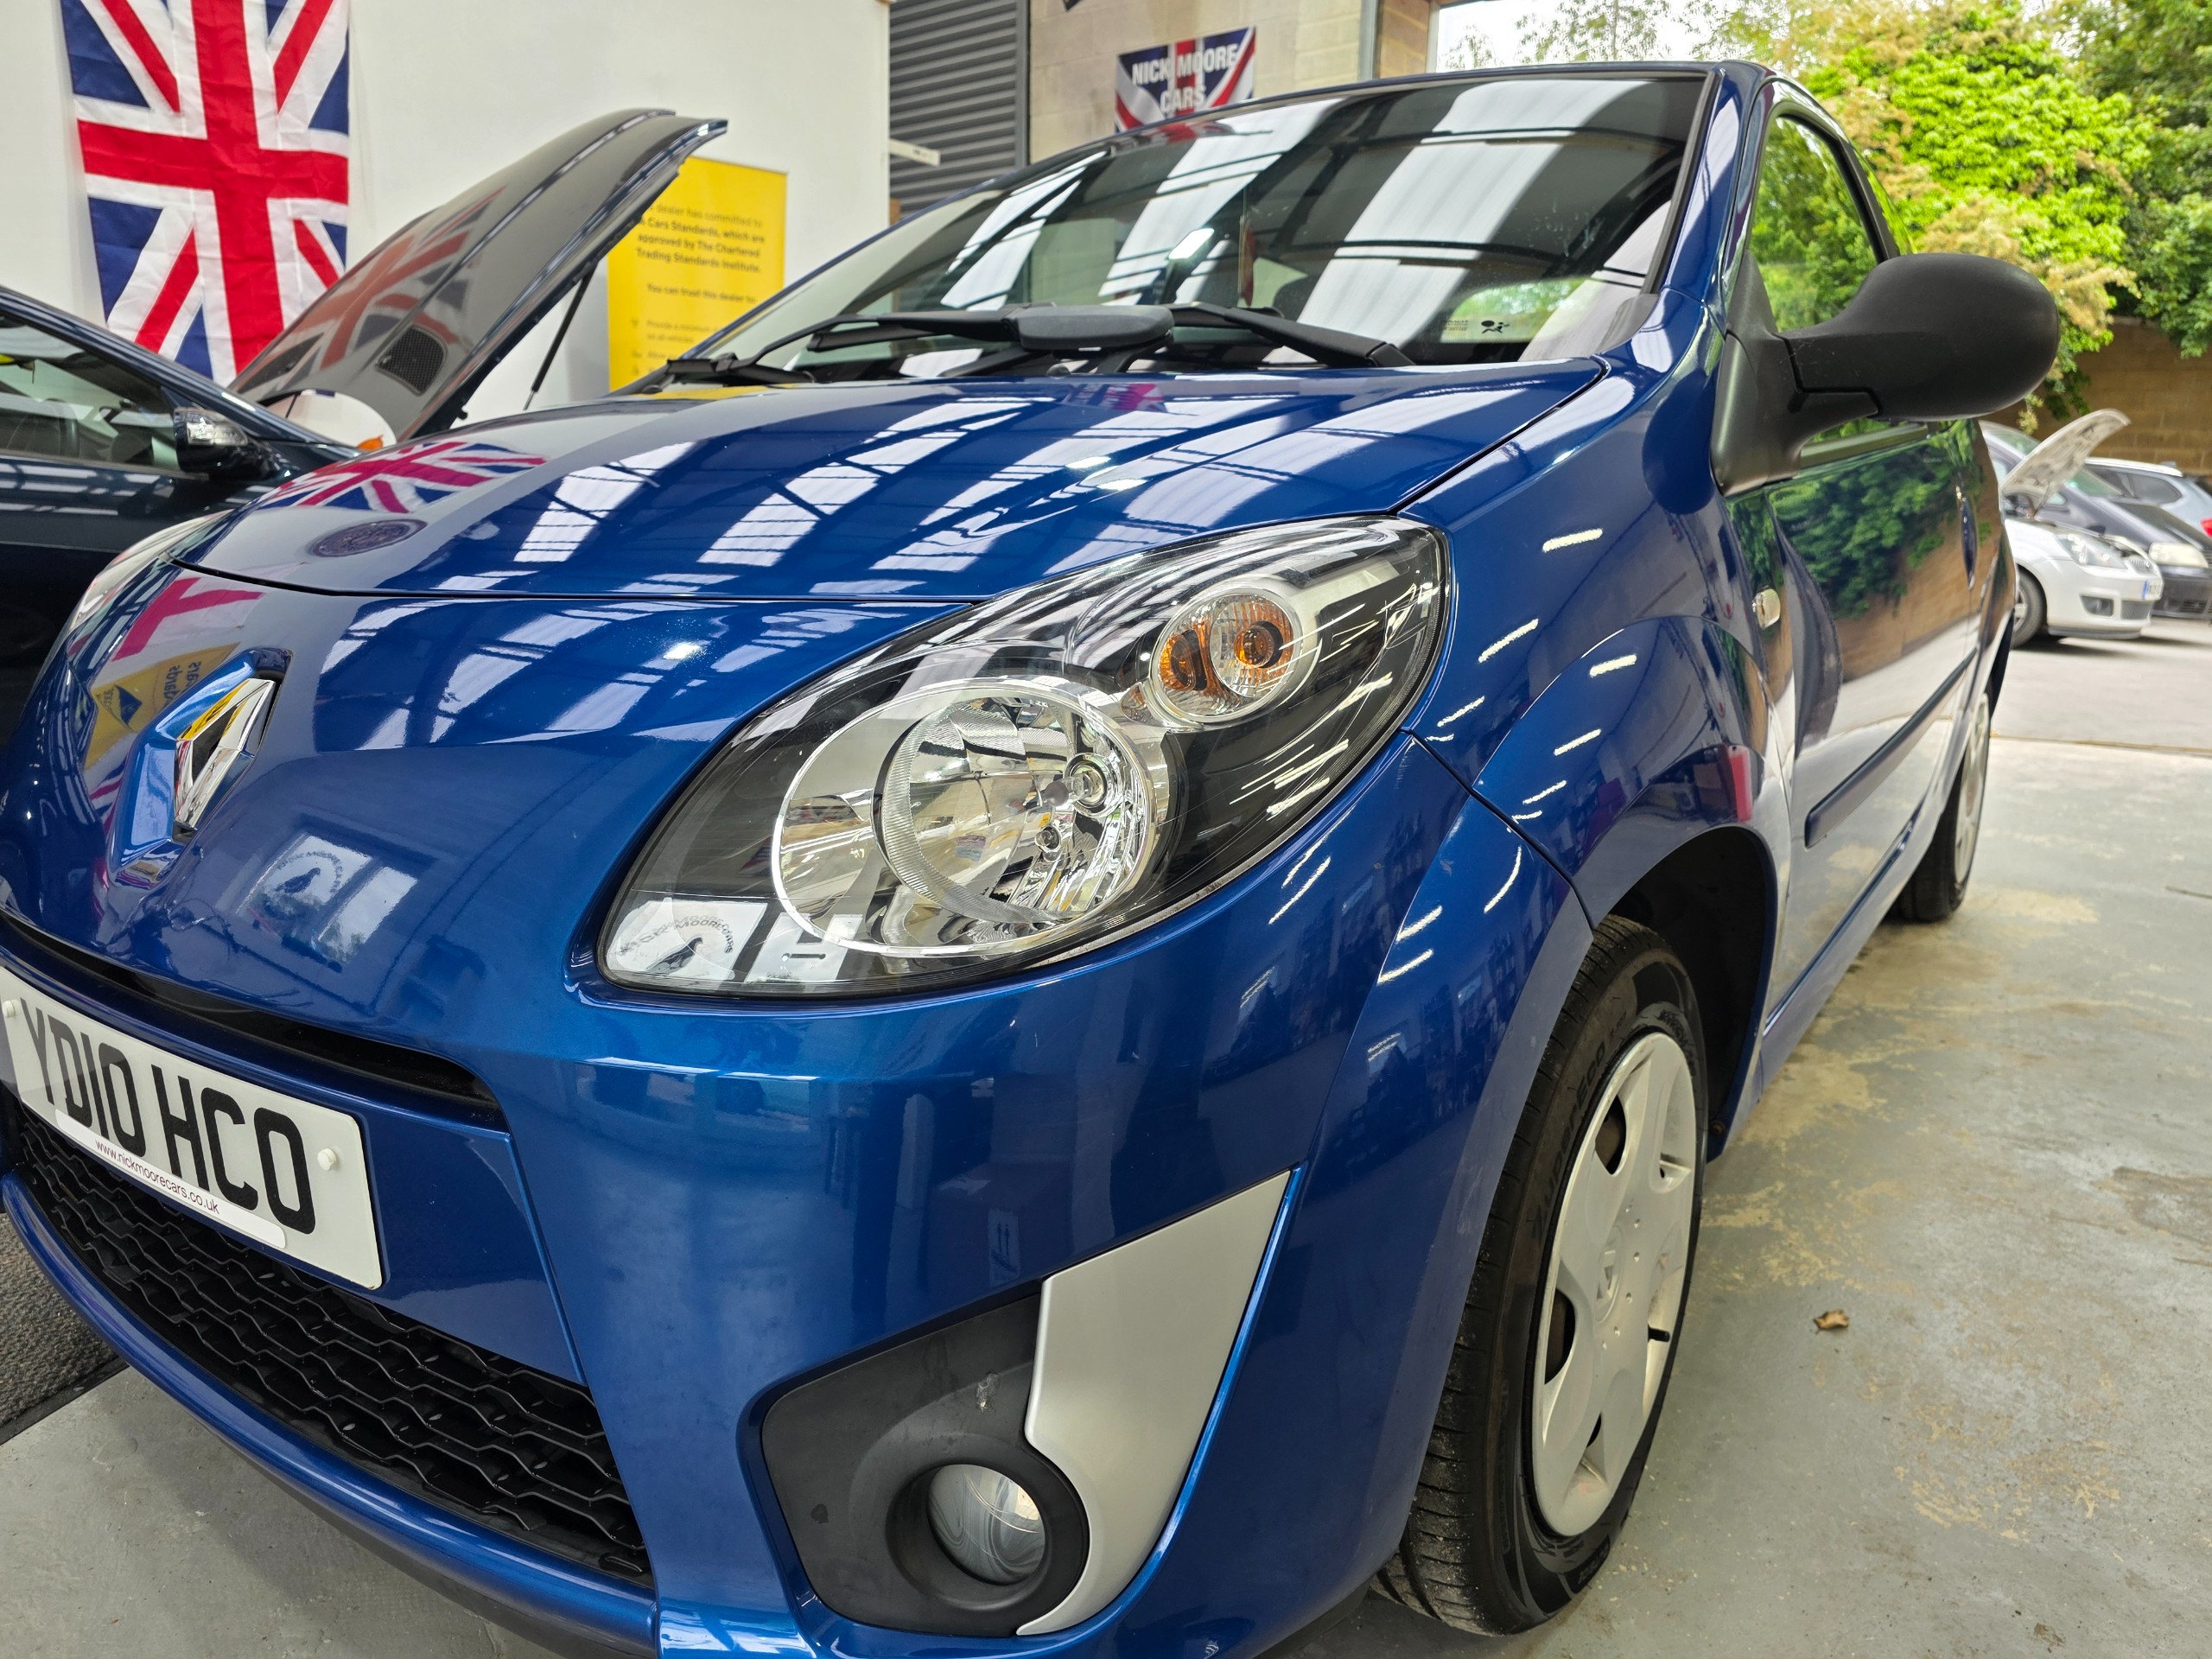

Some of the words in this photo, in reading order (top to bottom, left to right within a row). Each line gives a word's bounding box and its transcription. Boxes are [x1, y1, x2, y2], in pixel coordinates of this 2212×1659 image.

[1131, 58, 1172, 85] NICK
[1177, 43, 1237, 77] MOORE
[1160, 85, 1206, 113] CARS
[647, 216, 670, 230] Cars
[722, 228, 748, 242] which
[752, 234, 765, 244] are
[636, 247, 671, 264] Trading
[673, 252, 720, 269] Standards
[637, 233, 682, 248] approved
[683, 238, 695, 251] by
[696, 240, 713, 251] The
[715, 243, 761, 258] Chartered
[20, 997, 146, 1158] YD10
[150, 1064, 316, 1236] HCO
[95, 1139, 220, 1215] www.nickmoorecars.co.uk
